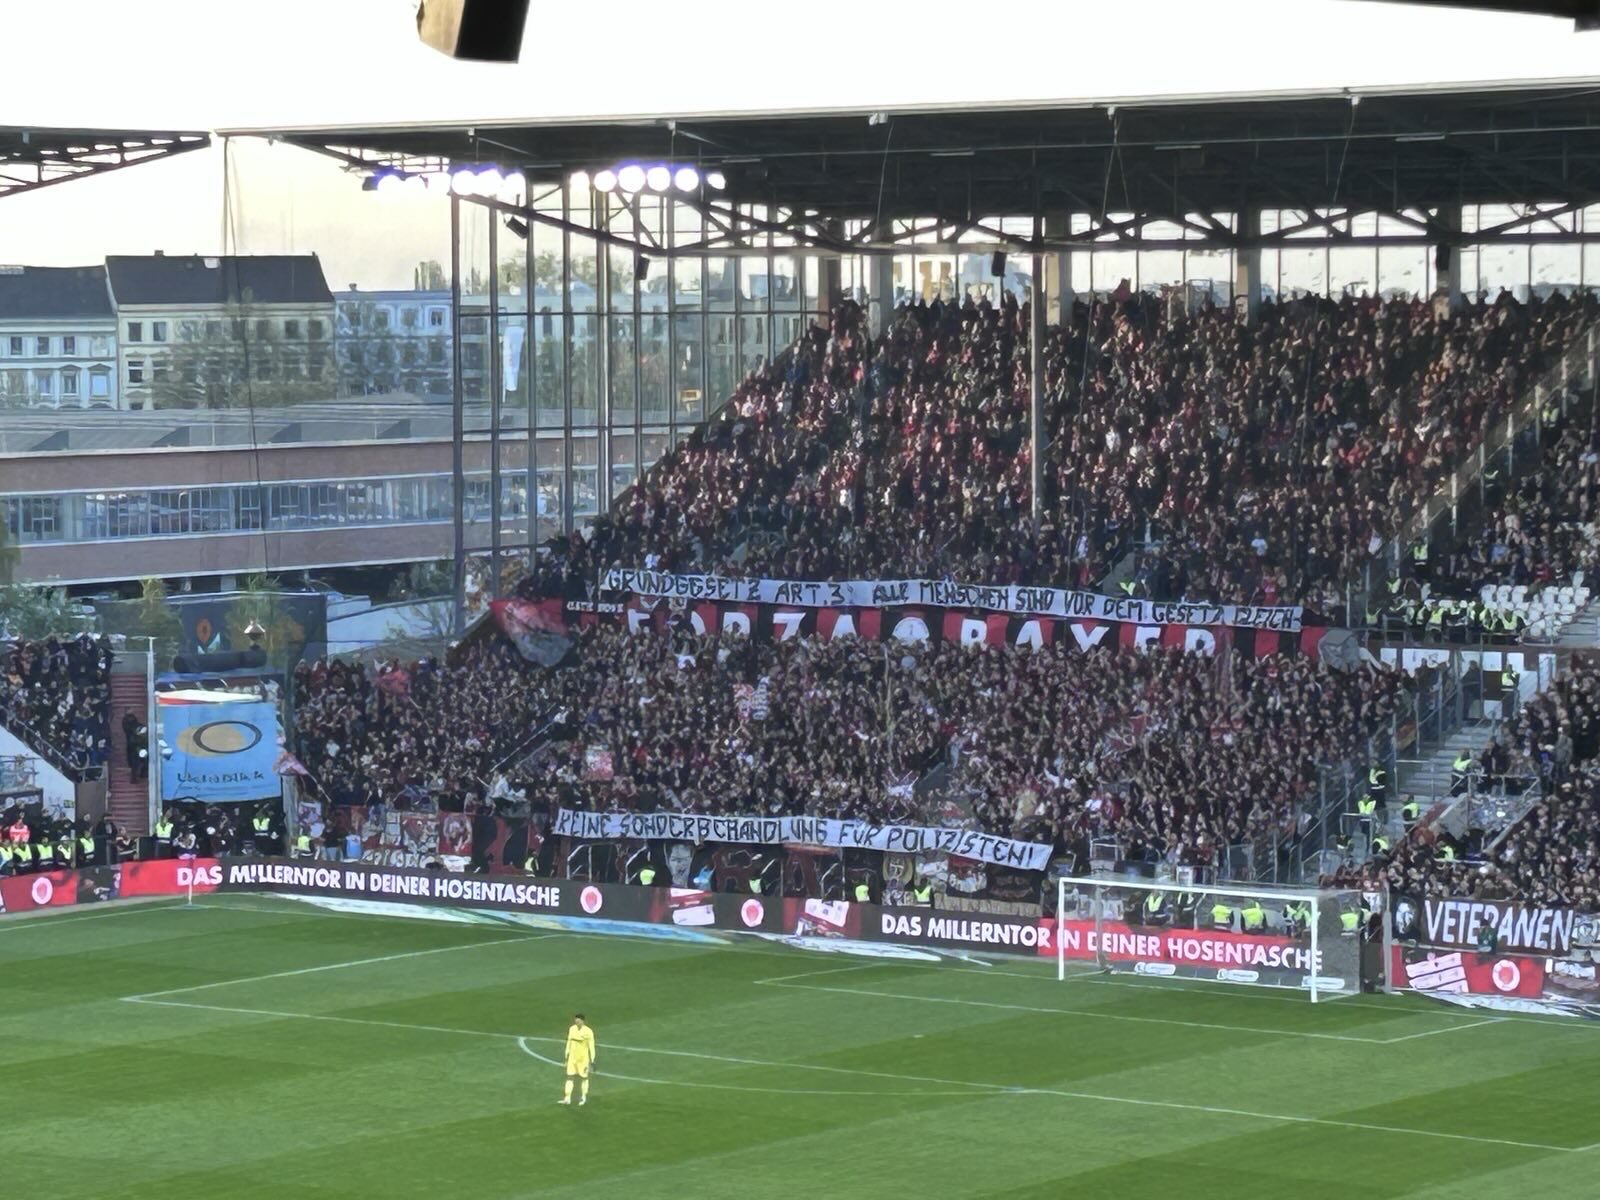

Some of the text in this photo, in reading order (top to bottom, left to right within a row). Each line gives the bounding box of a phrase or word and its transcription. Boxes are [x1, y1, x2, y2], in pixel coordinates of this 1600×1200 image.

[872, 582, 909, 603] ALLE
[920, 582, 1010, 609] MENSCHEN
[1014, 587, 1055, 611] SIND
[1063, 590, 1096, 617] VOR
[1103, 598, 1143, 622] DEM
[1152, 602, 1224, 626] GESETZ
[557, 810, 611, 837] KEINE
[621, 814, 828, 844] SONDERBEHANDLUNG
[177, 865, 223, 887] DAS
[345, 871, 366, 891] IN
[370, 873, 430, 897] DEINER
[435, 878, 560, 907] HOSENTASCHE
[881, 913, 922, 937] DAS
[927, 917, 1051, 948] MILLERNTOR
[1087, 931, 1161, 957] DEINER
[1168, 936, 1323, 971] HOSENTASCHE
